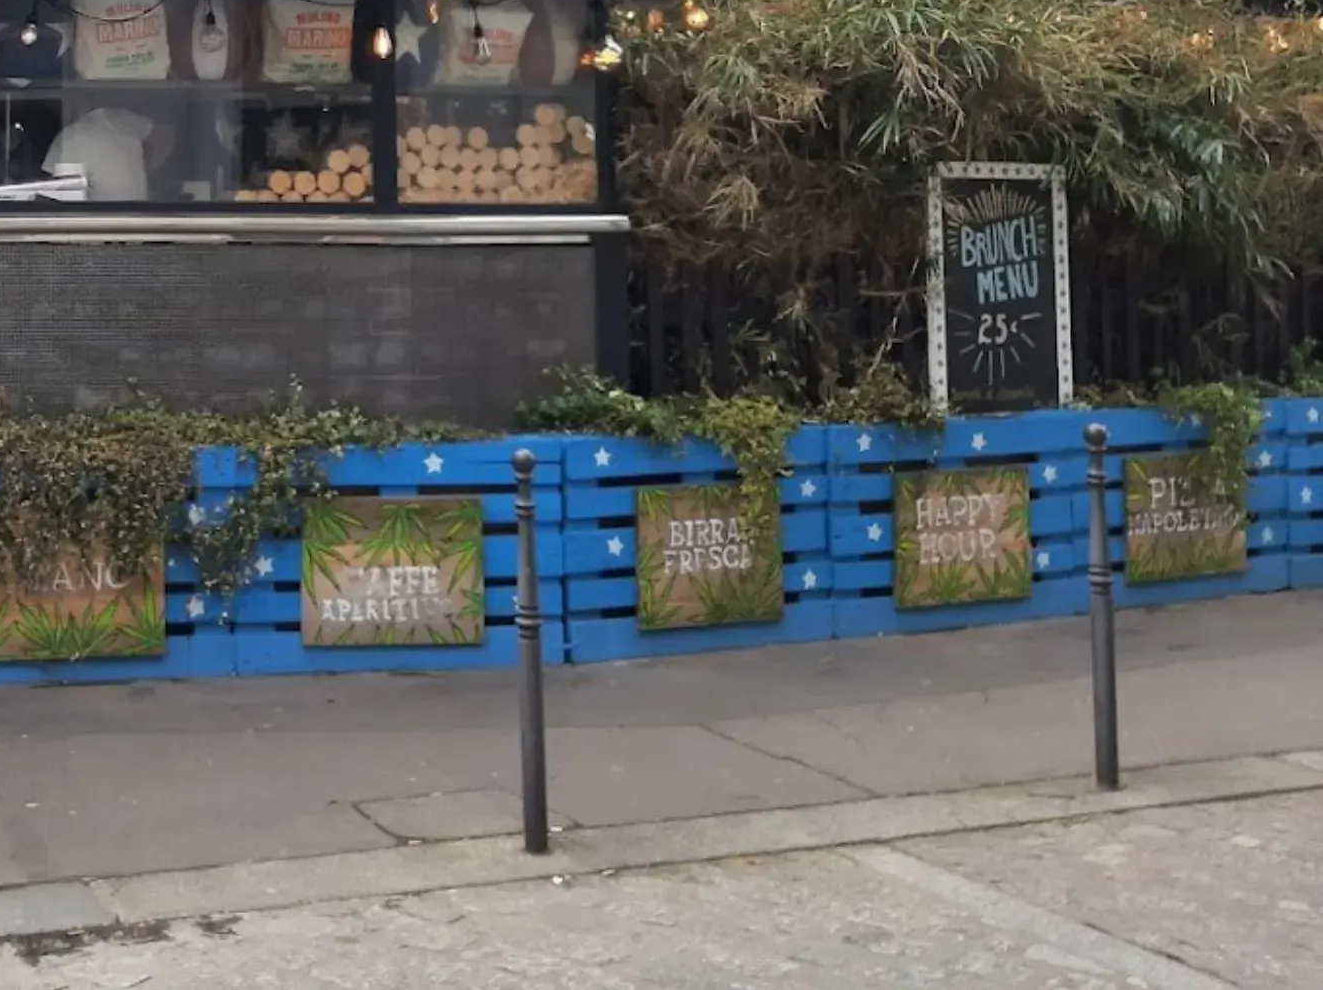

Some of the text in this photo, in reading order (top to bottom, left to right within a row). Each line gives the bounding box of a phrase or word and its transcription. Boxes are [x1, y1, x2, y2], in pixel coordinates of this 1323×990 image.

[960, 215, 1038, 268] BRUNCH
[977, 261, 1039, 304] MENU
[916, 493, 1005, 530] HAPPY
[669, 517, 741, 548] BIRRA
[919, 528, 997, 565] HOUR
